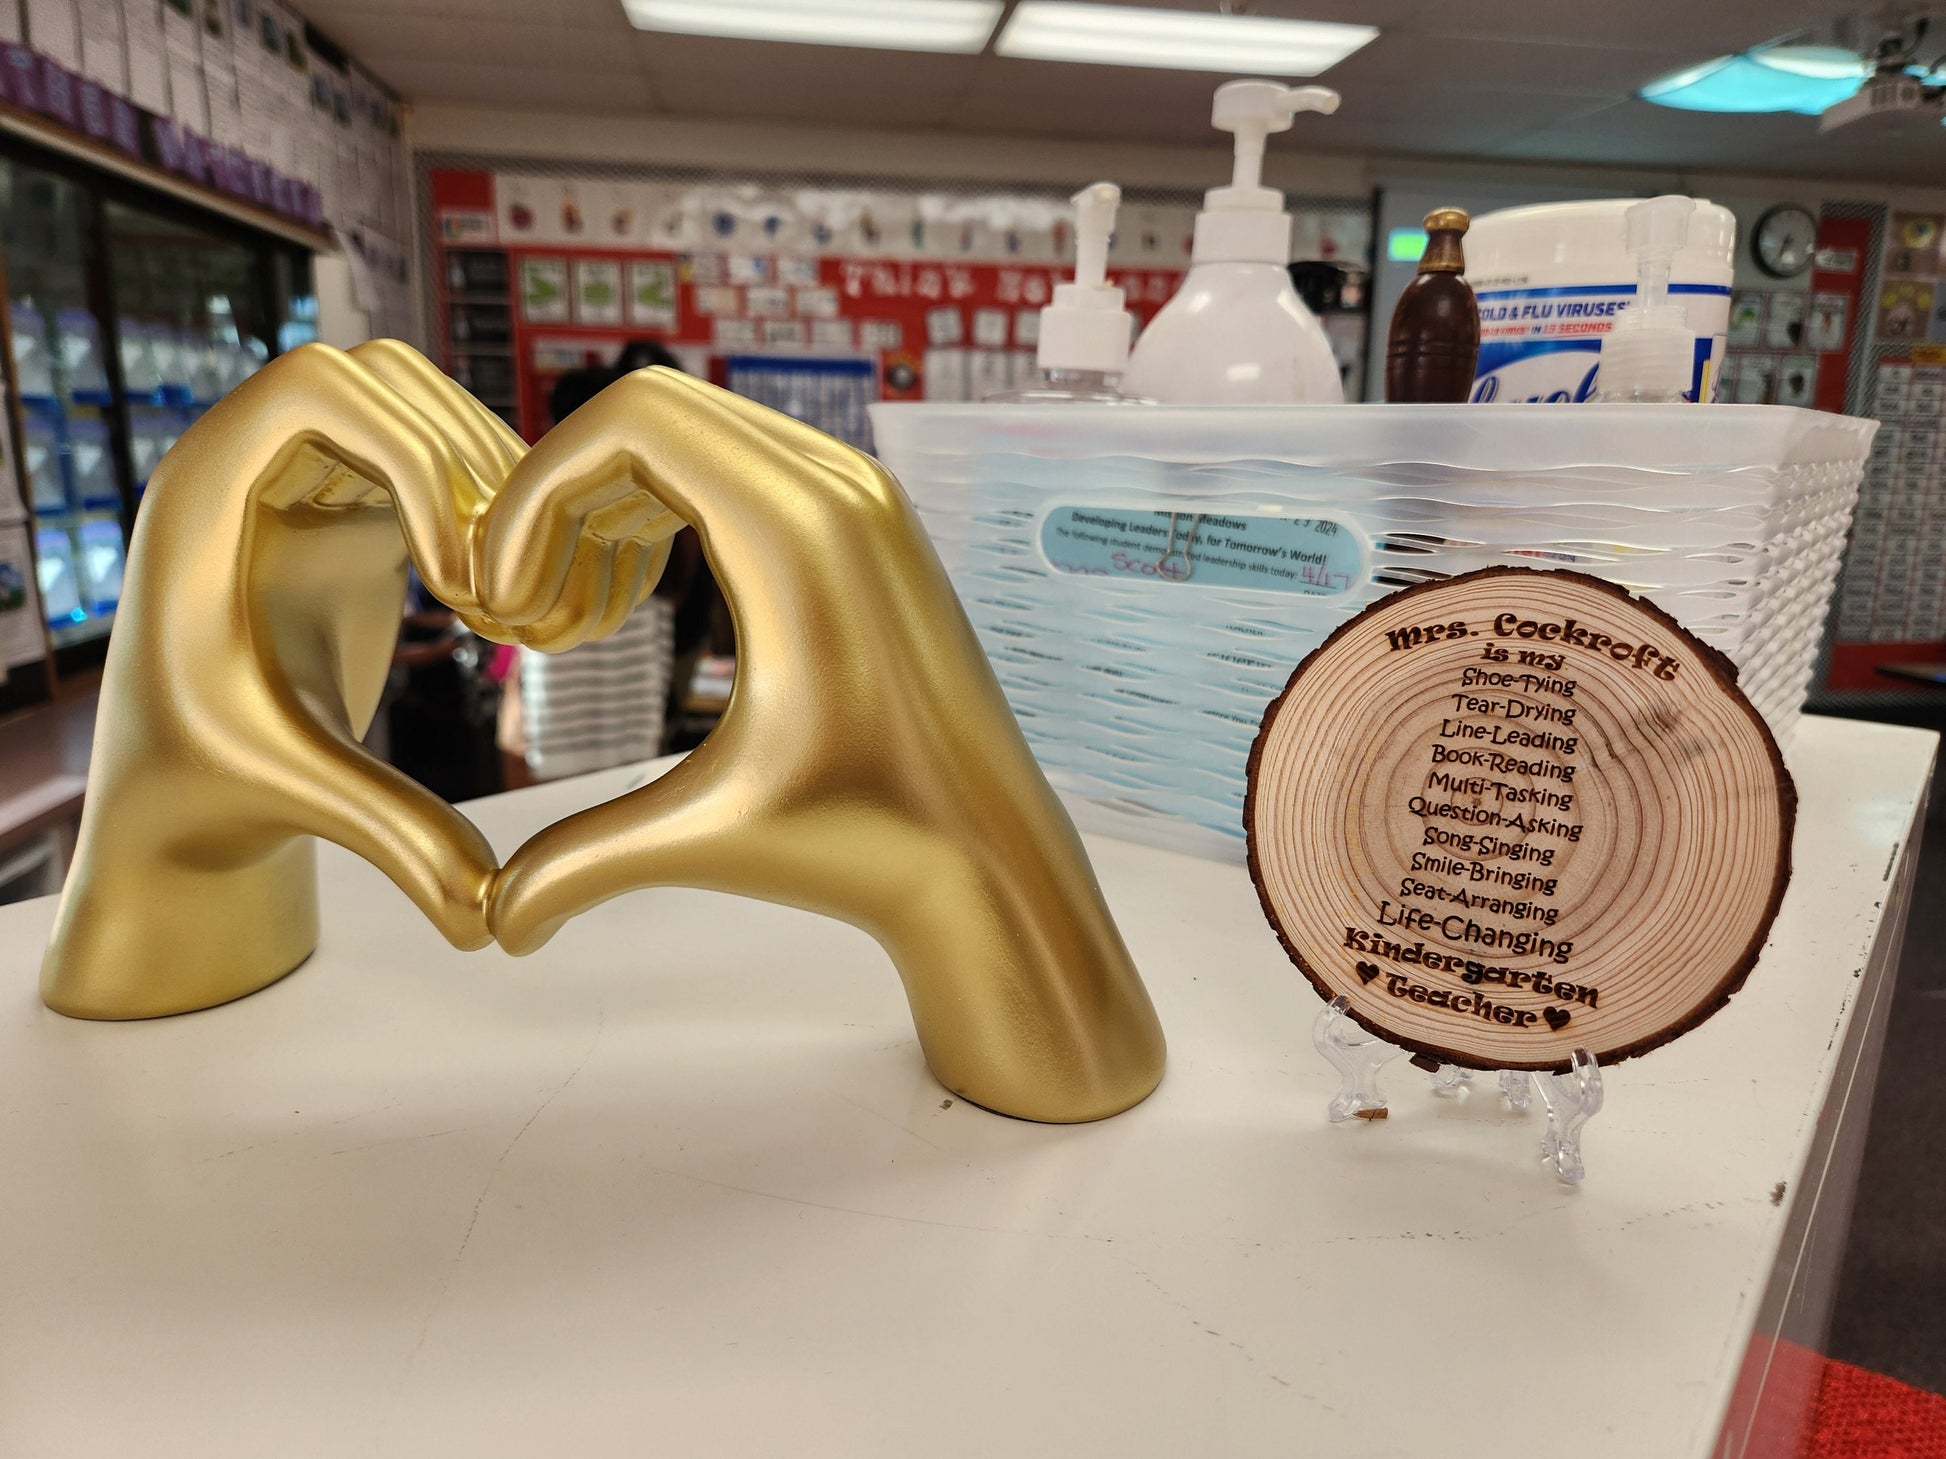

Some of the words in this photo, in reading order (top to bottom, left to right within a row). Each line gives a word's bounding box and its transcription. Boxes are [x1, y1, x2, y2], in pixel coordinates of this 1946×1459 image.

[1509, 306, 1518, 319] &
[1521, 304, 1553, 320] FLU
[1558, 322, 1613, 335] SECONDS
[1071, 511, 1127, 533] Developing
[1129, 521, 1168, 538] Leaders
[1206, 534, 1222, 547] for
[1224, 538, 1287, 559] Tomorrow's
[1290, 549, 1327, 566] World!
[1109, 538, 1141, 551] student
[1202, 554, 1246, 571] leadership
[1249, 562, 1268, 574] skills
[1270, 567, 1298, 580] today:
[1385, 620, 1480, 652] Mrs.
[1493, 613, 1681, 682] Cockroft
[1480, 642, 1510, 662] is
[1517, 649, 1566, 672] my
[1461, 667, 1577, 697] Shoe-Tying
[1451, 693, 1577, 726] Tear-Drying
[1439, 719, 1578, 755] Line-Leading
[1431, 744, 1577, 783] Book-Reading
[1428, 771, 1574, 812] Multi-Tasking
[1408, 796, 1584, 842] Question-Asking
[1423, 826, 1556, 866] Song-Singing
[1410, 851, 1559, 896] Smile-Bringing
[1400, 877, 1560, 926] Seat-Arranging
[1376, 900, 1574, 964] Life-Changing
[1343, 926, 1600, 1009] Kindergarten
[1385, 971, 1538, 1029] Teacher
